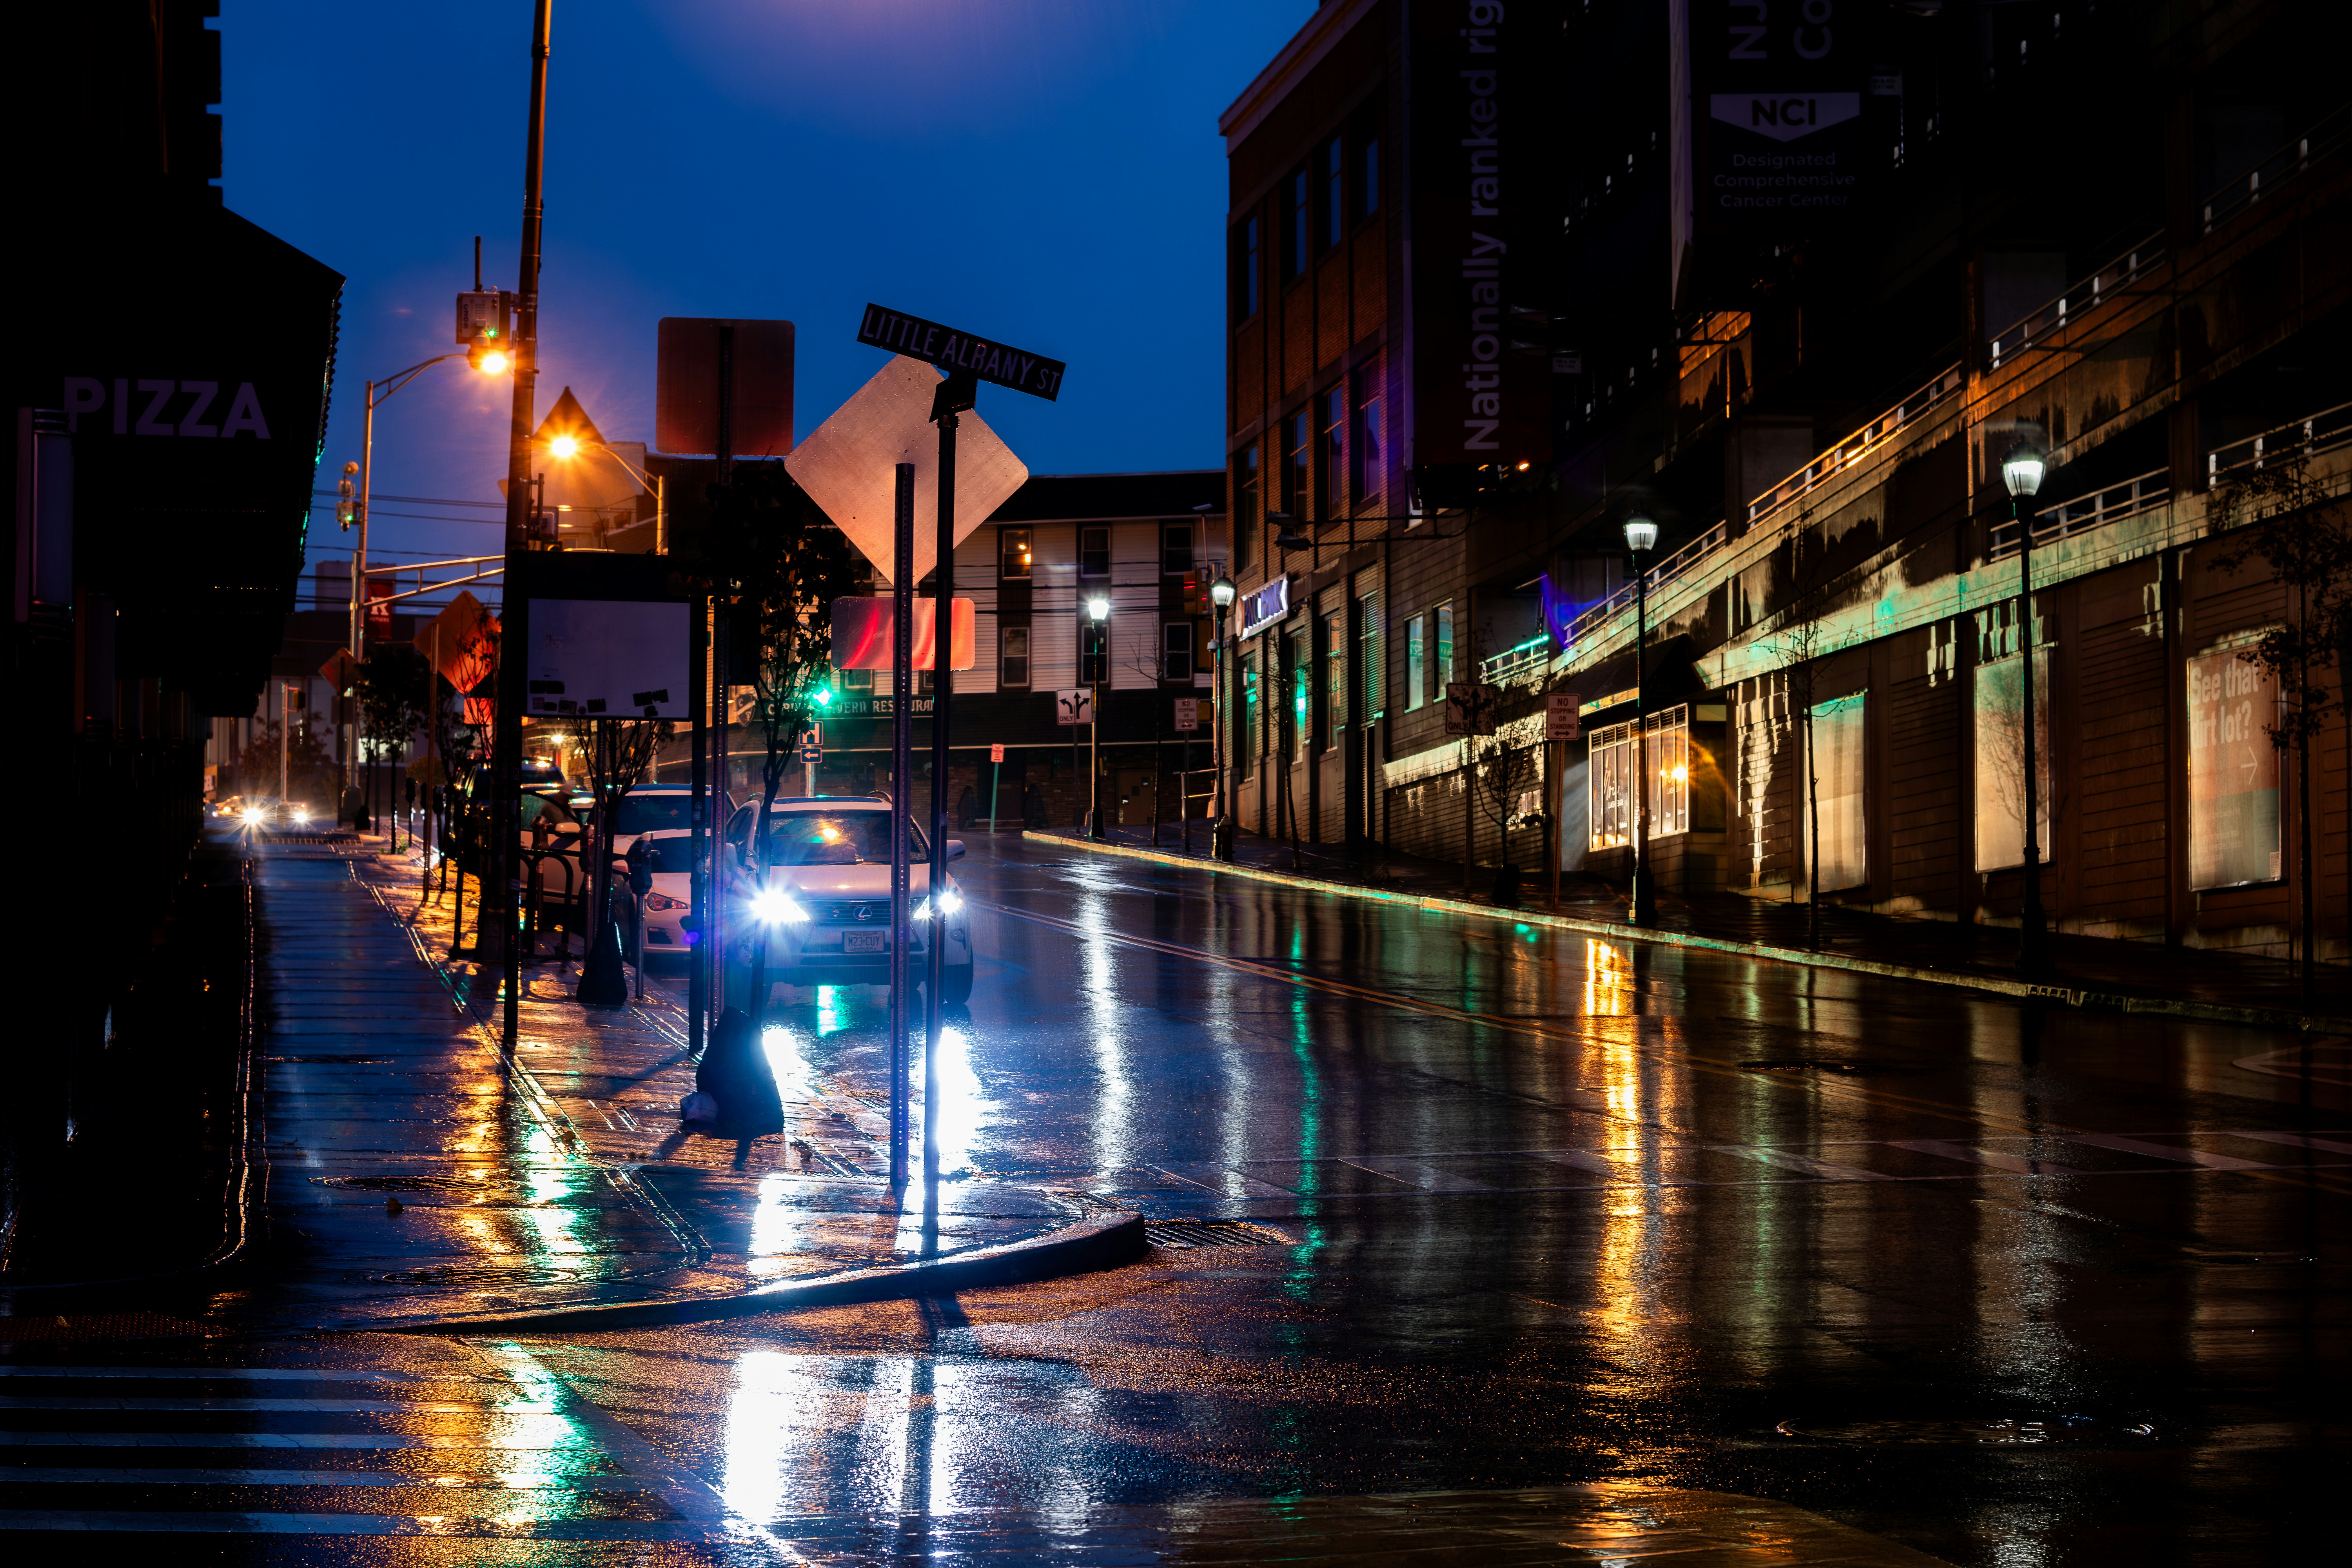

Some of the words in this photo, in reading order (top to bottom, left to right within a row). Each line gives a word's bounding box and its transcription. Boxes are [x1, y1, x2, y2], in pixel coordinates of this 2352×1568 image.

[1459, 0, 1506, 54] rig
[1793, 0, 1833, 60] Co
[1752, 99, 1816, 125] NCI
[1459, 69, 1499, 216] ranked
[1733, 152, 1837, 170] Designated
[1713, 172, 1856, 190] Comprehensive
[1720, 194, 1784, 208] Cancer
[1789, 192, 1849, 207] Center
[862, 309, 940, 357] LITTLE
[941, 334, 1036, 385] ALBANY
[1037, 367, 1061, 393] ST
[1462, 230, 1508, 450] Nationally
[63, 376, 272, 439] PIZZA
[1557, 698, 1568, 707] NO
[2191, 666, 2221, 706] See
[2225, 659, 2259, 698] that
[1448, 722, 1468, 731] ONLY
[2221, 700, 2252, 744] lot?
